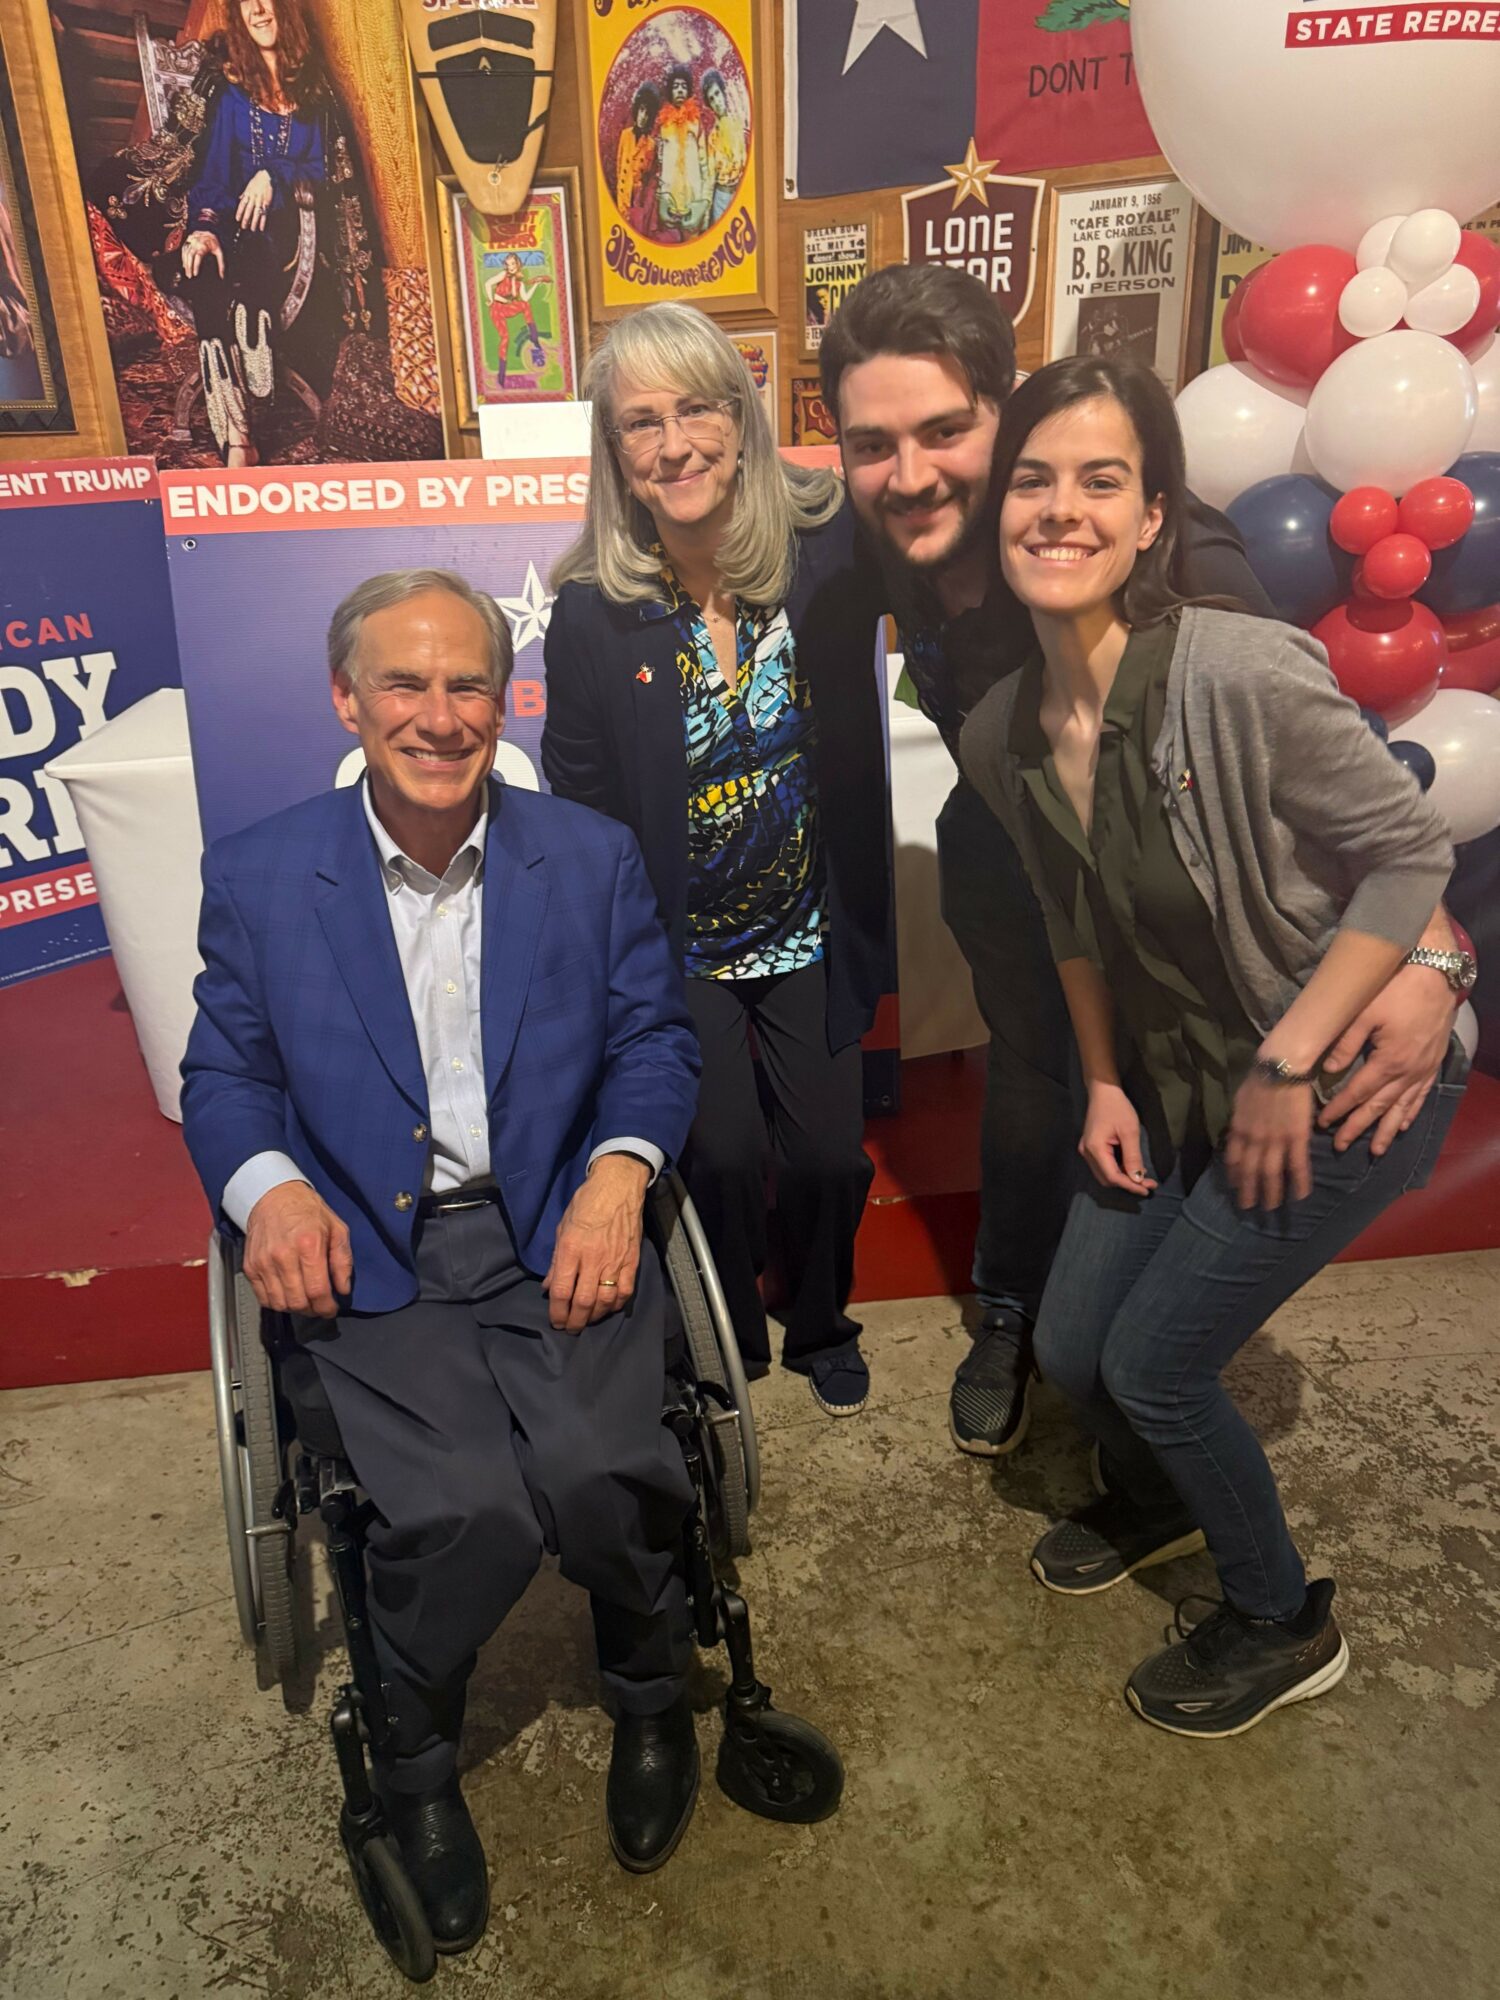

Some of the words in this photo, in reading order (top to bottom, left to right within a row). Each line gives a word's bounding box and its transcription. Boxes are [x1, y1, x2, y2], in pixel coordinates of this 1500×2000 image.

[1295, 13, 1394, 41] STATE
[1403, 10, 1500, 34] REPRE
[1028, 57, 1108, 98] DONT
[1089, 196, 1129, 211] JANUARY
[1131, 195, 1139, 209] 9,
[1143, 193, 1162, 206] 1956
[1073, 230, 1101, 242] LAKE
[1105, 225, 1157, 240] CHARLES,
[1162, 223, 1176, 234] LA
[828, 240, 844, 251] MAY
[1222, 234, 1252, 256] JIM
[1072, 247, 1091, 281] B.
[1096, 244, 1116, 279] B.
[1122, 239, 1173, 277] KING
[806, 264, 867, 283] JOHNNY
[928, 256, 1012, 293] AR
[1066, 284, 1085, 296] IN
[1090, 277, 1176, 295] PERSON
[54, 467, 151, 493] TRUMP
[168, 478, 406, 518] ENDORSED
[417, 476, 473, 508] BY
